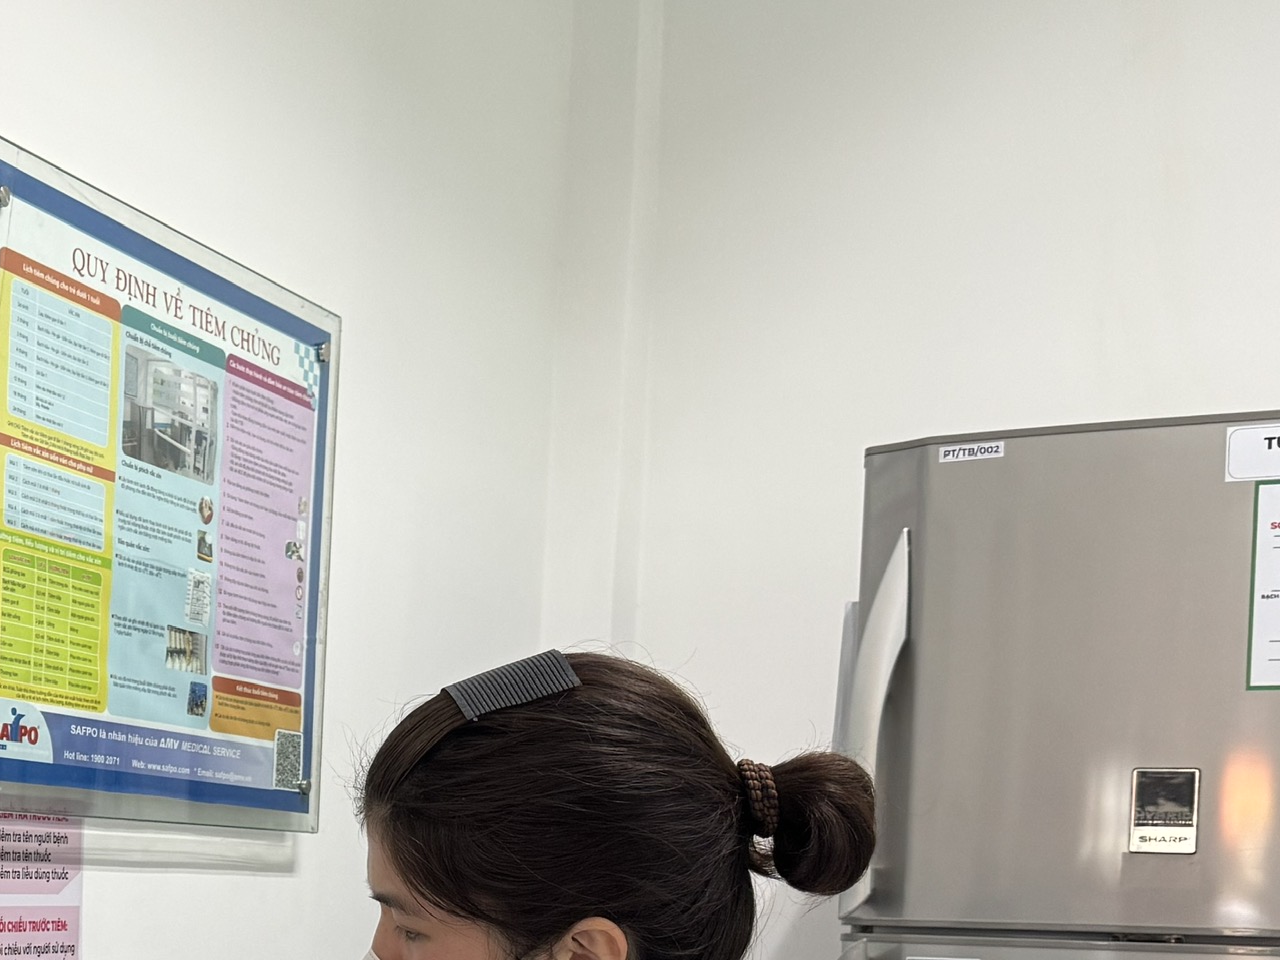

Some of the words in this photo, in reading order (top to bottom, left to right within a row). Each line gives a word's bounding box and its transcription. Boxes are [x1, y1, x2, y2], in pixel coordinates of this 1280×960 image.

[72, 247, 109, 283] QUY
[115, 267, 157, 308] ĐỊNH
[163, 286, 183, 321] VỀ
[189, 303, 227, 342] TIÊM
[231, 324, 281, 366] CHỦNG
[1263, 436, 1280, 450] T
[944, 445, 1000, 459] PT/TB/002
[1270, 521, 1280, 530] S
[70, 725, 98, 738] SAFPO
[100, 728, 106, 739] là
[108, 731, 126, 742] nhãn
[128, 733, 143, 745] hiệu
[145, 736, 157, 747] của
[181, 741, 211, 755] MEDICAL
[213, 745, 241, 759] SERVICE
[64, 751, 75, 761] Hot
[91, 754, 104, 764] 1900
[106, 756, 120, 766] 2071
[132, 759, 146, 769] Web:
[13, 832, 21, 842] tra
[23, 831, 33, 843] tên
[34, 832, 52, 846] người
[53, 833, 68, 846] bệnh
[12, 869, 20, 879] tra
[52, 867, 69, 880] thuốc
[7, 916, 27, 932] CHIẾU
[4, 942, 21, 955] chiếu
[22, 943, 32, 954] với
[33, 942, 51, 957] người
